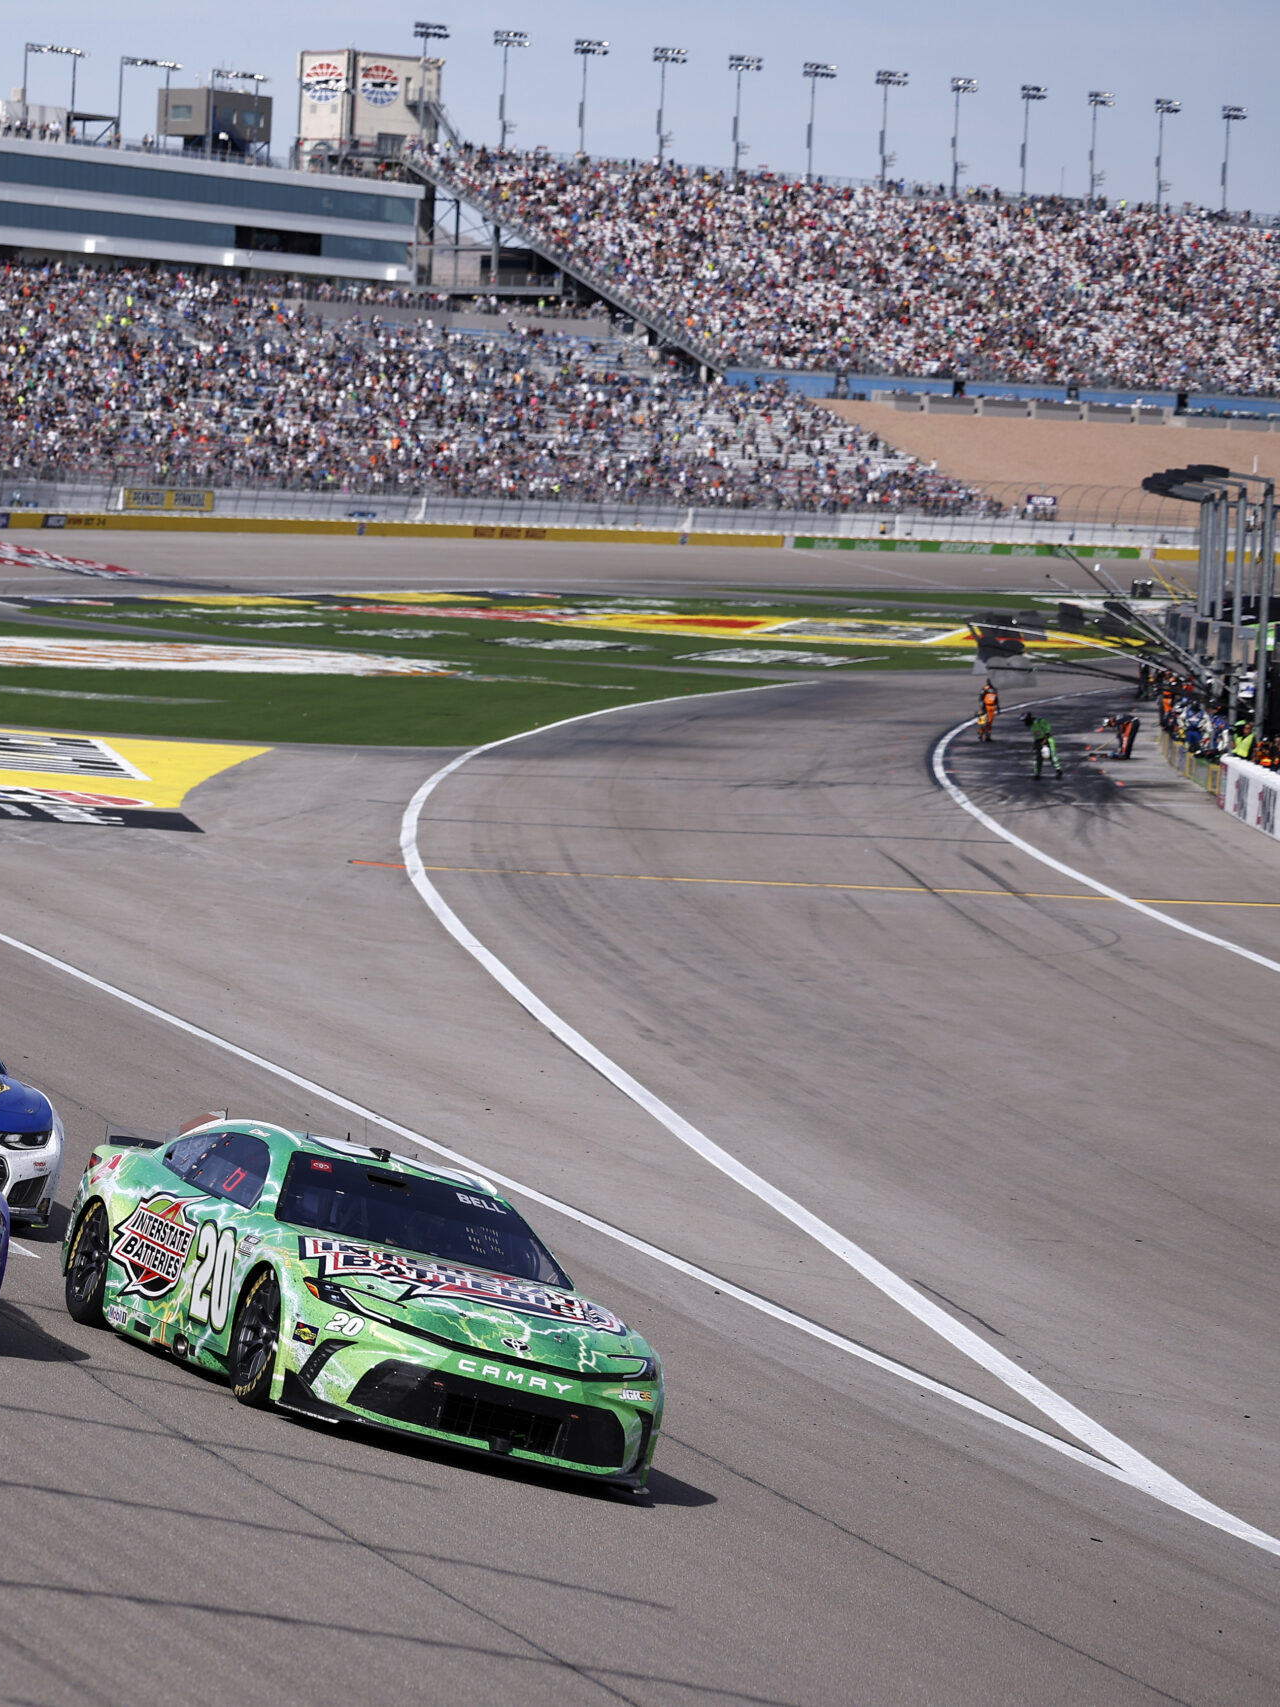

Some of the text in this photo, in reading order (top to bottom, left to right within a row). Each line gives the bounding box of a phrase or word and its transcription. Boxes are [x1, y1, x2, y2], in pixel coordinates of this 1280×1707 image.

[455, 1192, 507, 1216] BELL
[130, 1210, 191, 1253] INTERSTATE
[121, 1235, 181, 1279] BATTERIES
[189, 1221, 237, 1333] 20
[324, 1311, 366, 1337] 20
[457, 1358, 574, 1395] CAMRY
